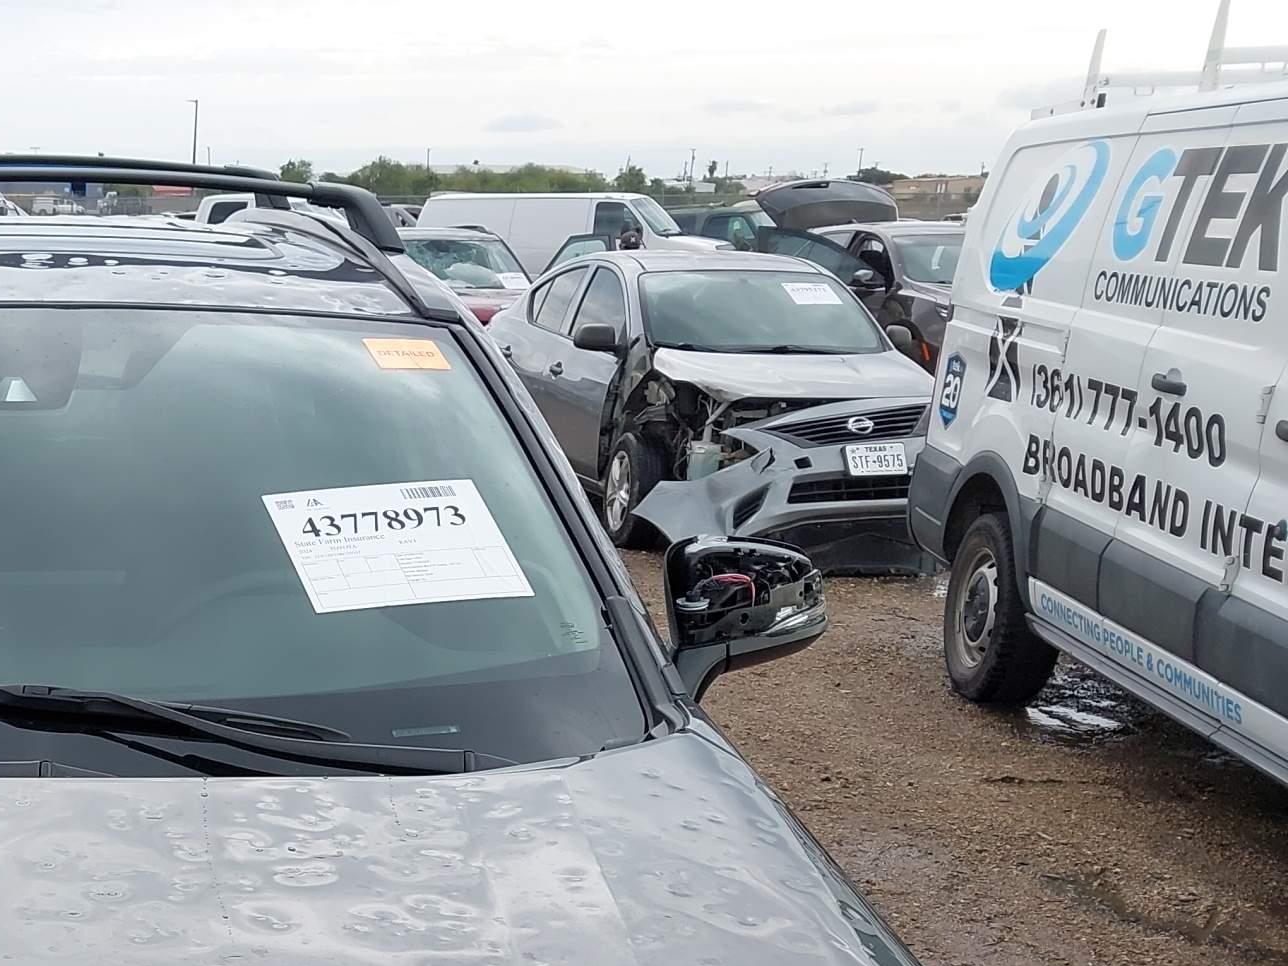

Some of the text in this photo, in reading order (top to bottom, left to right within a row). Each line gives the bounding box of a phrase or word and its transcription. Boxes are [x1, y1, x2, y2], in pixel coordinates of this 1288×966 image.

[1112, 142, 1288, 273] GTEK
[1094, 270, 1271, 323] COMMUNICATIONS
[376, 350, 435, 358] DETAILED
[941, 373, 961, 409] 20
[1031, 363, 1227, 468] (361) 777-1400
[1022, 433, 1190, 538] BROADBAND
[294, 540, 316, 548] State
[343, 534, 385, 543] Insurance
[302, 505, 466, 538] 43778973
[1040, 593, 1243, 725] CONNECTING PEOPLE & COMMUNITIES
